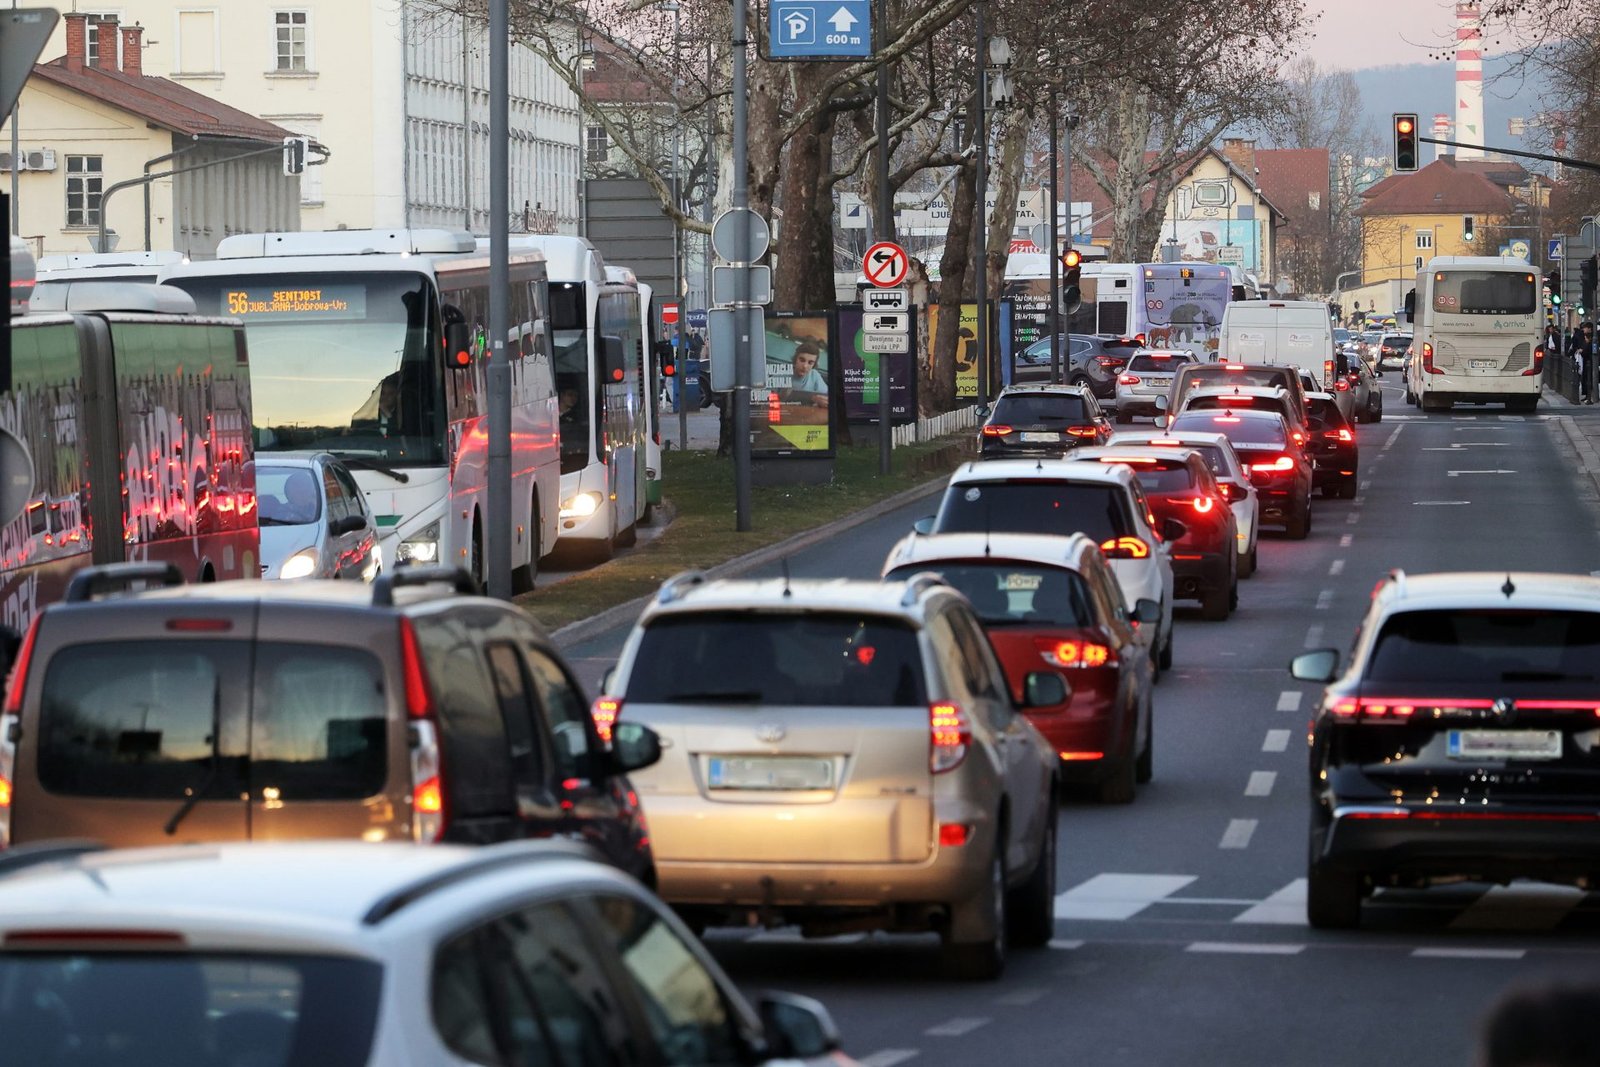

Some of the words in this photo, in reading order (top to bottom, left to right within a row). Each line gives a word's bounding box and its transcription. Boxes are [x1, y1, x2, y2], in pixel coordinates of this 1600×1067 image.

[826, 34, 848, 44] 600
[850, 36, 861, 44] m
[1182, 269, 1190, 278] 18
[228, 292, 248, 314] 56
[1503, 320, 1526, 328] arriva
[868, 335, 894, 343] Dovoljeno
[844, 368, 861, 376] Ključ
